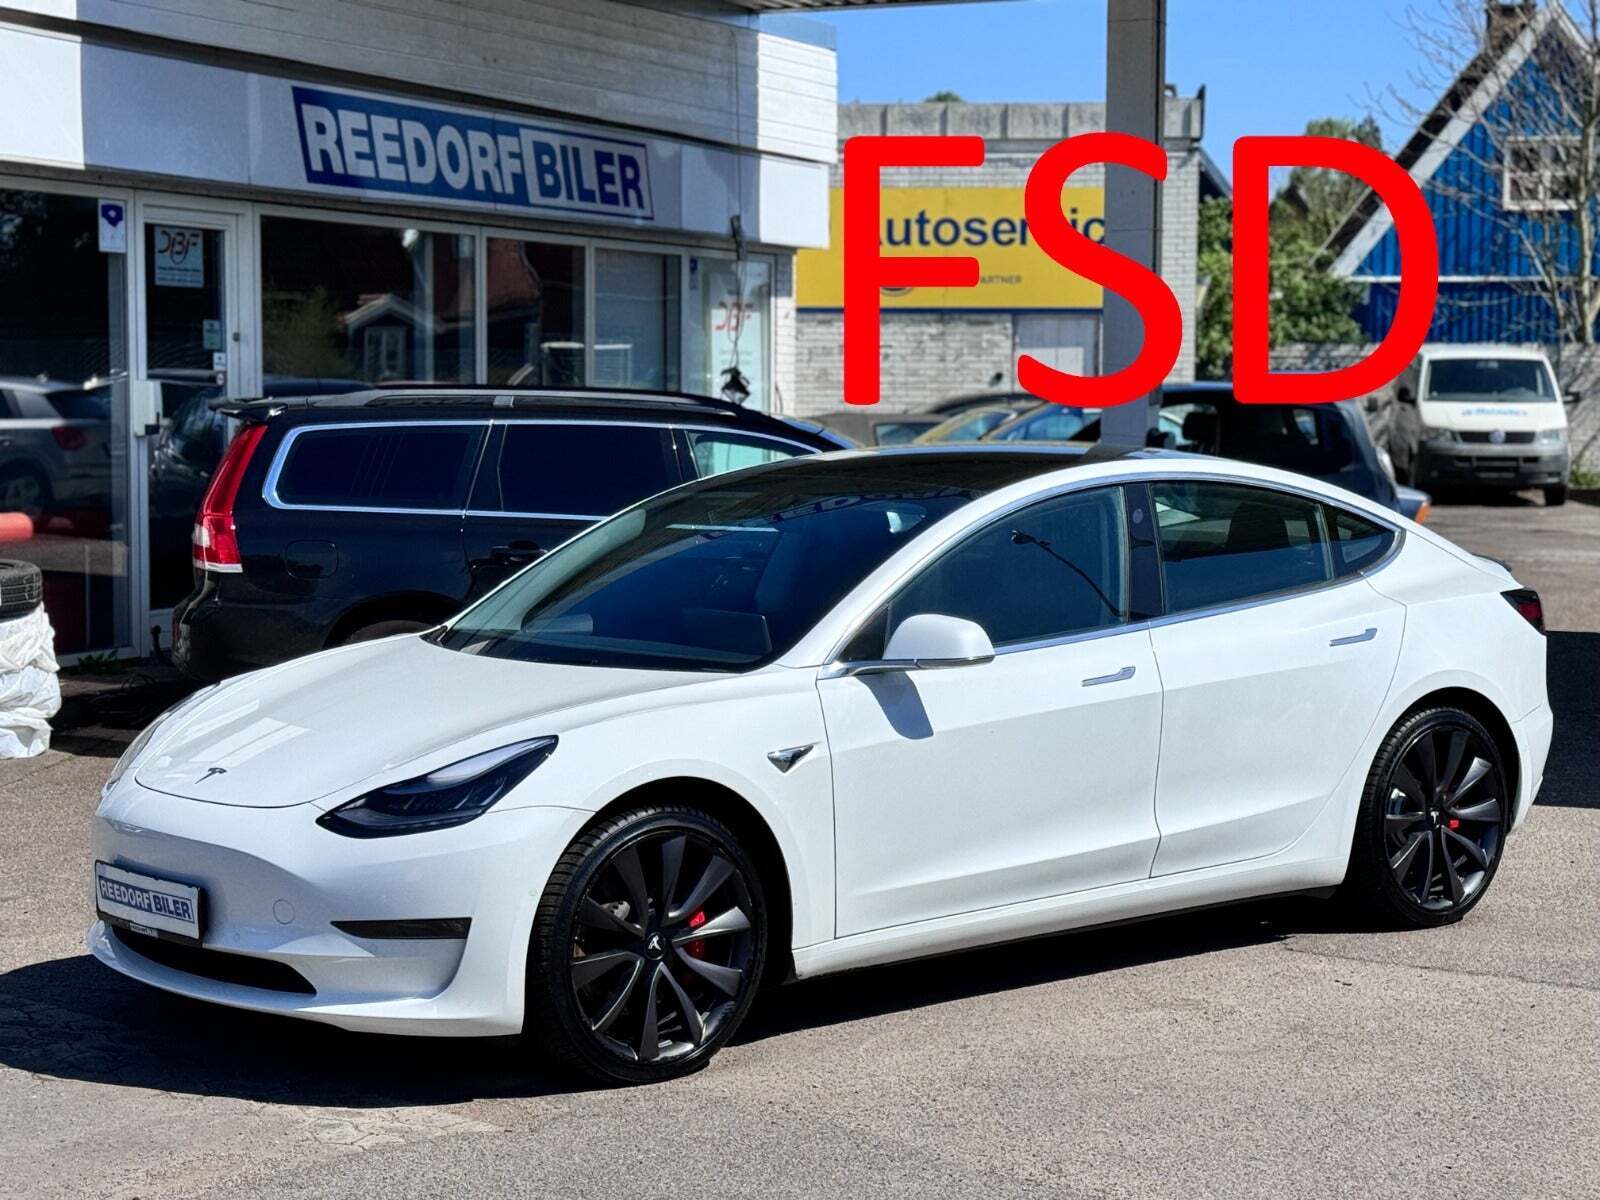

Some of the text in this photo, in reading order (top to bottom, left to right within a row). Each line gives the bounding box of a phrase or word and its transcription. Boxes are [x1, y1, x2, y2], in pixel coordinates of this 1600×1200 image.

[300, 103, 645, 209] REEDORF BILER
[979, 274, 1023, 285] ARTNER
[100, 880, 191, 920] REEDORF BILER
